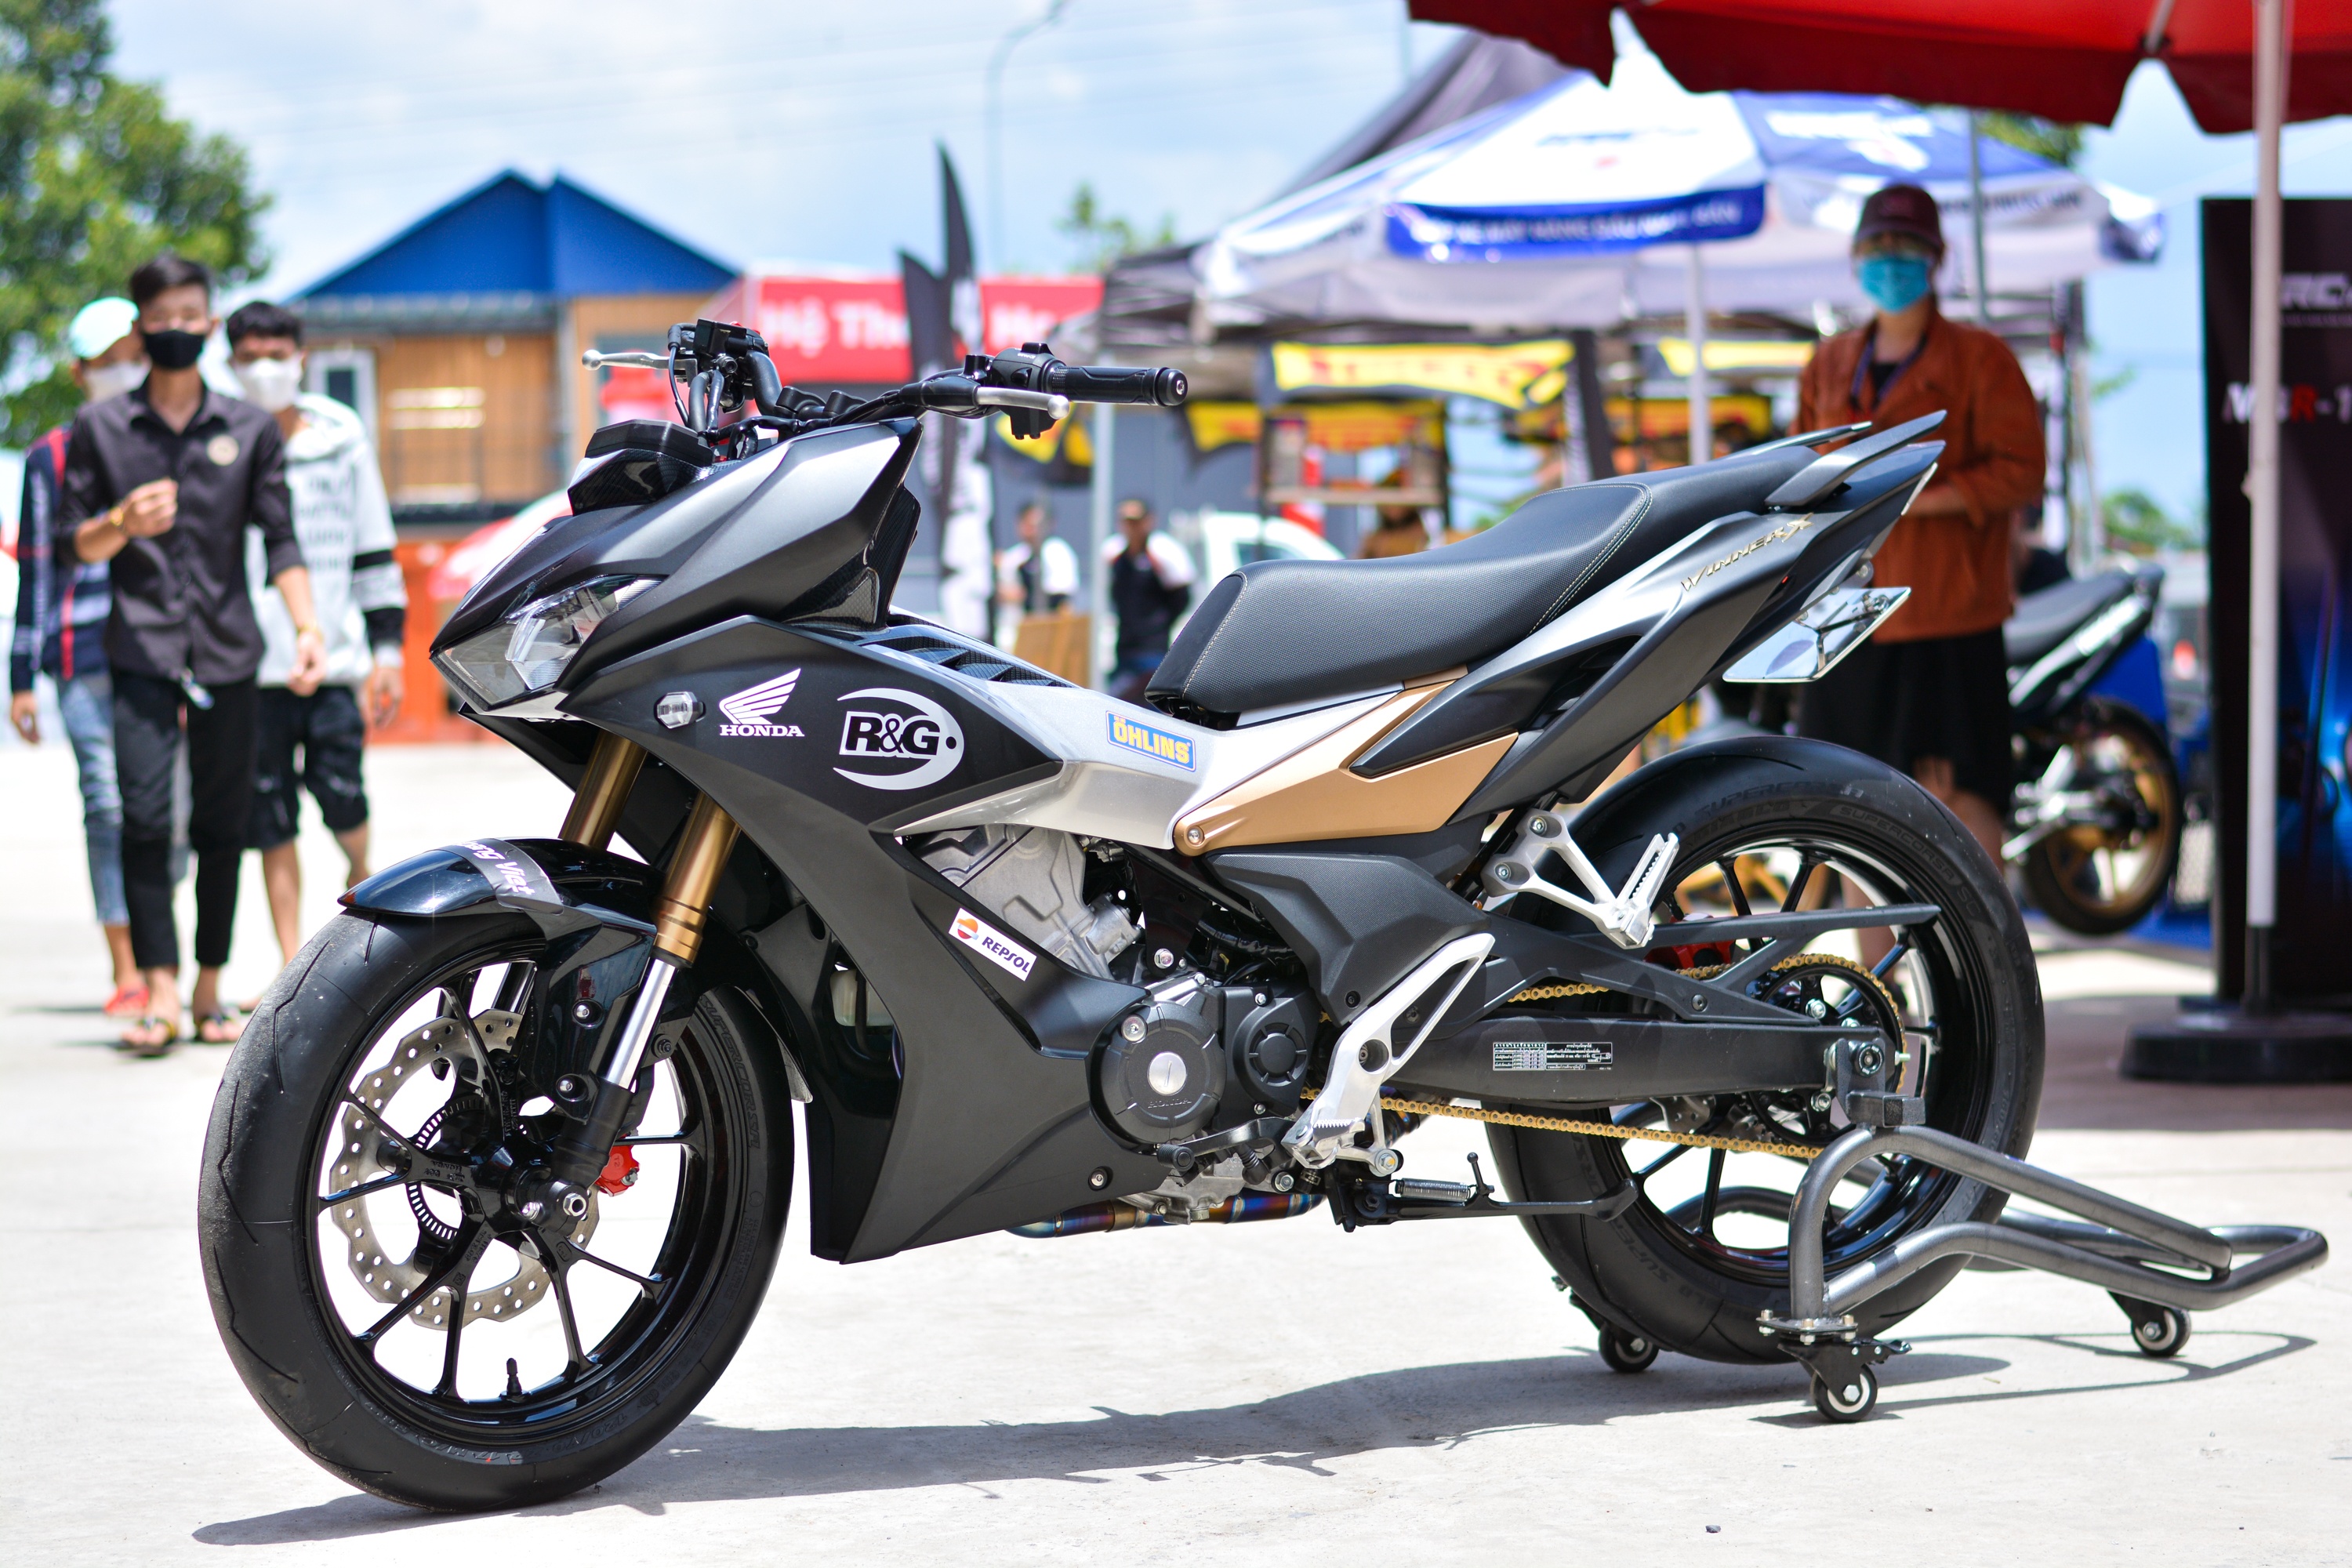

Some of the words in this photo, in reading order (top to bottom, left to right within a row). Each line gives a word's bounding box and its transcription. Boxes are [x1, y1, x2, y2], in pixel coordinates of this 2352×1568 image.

[1681, 527, 1788, 592] WINNER
[719, 724, 805, 737] HONDA
[1113, 715, 1191, 764] ÖHLINS
[982, 937, 1030, 972] REPSOL
[700, 994, 760, 1149] SUPERCORSA
[1147, 1098, 1192, 1109] HONDA
